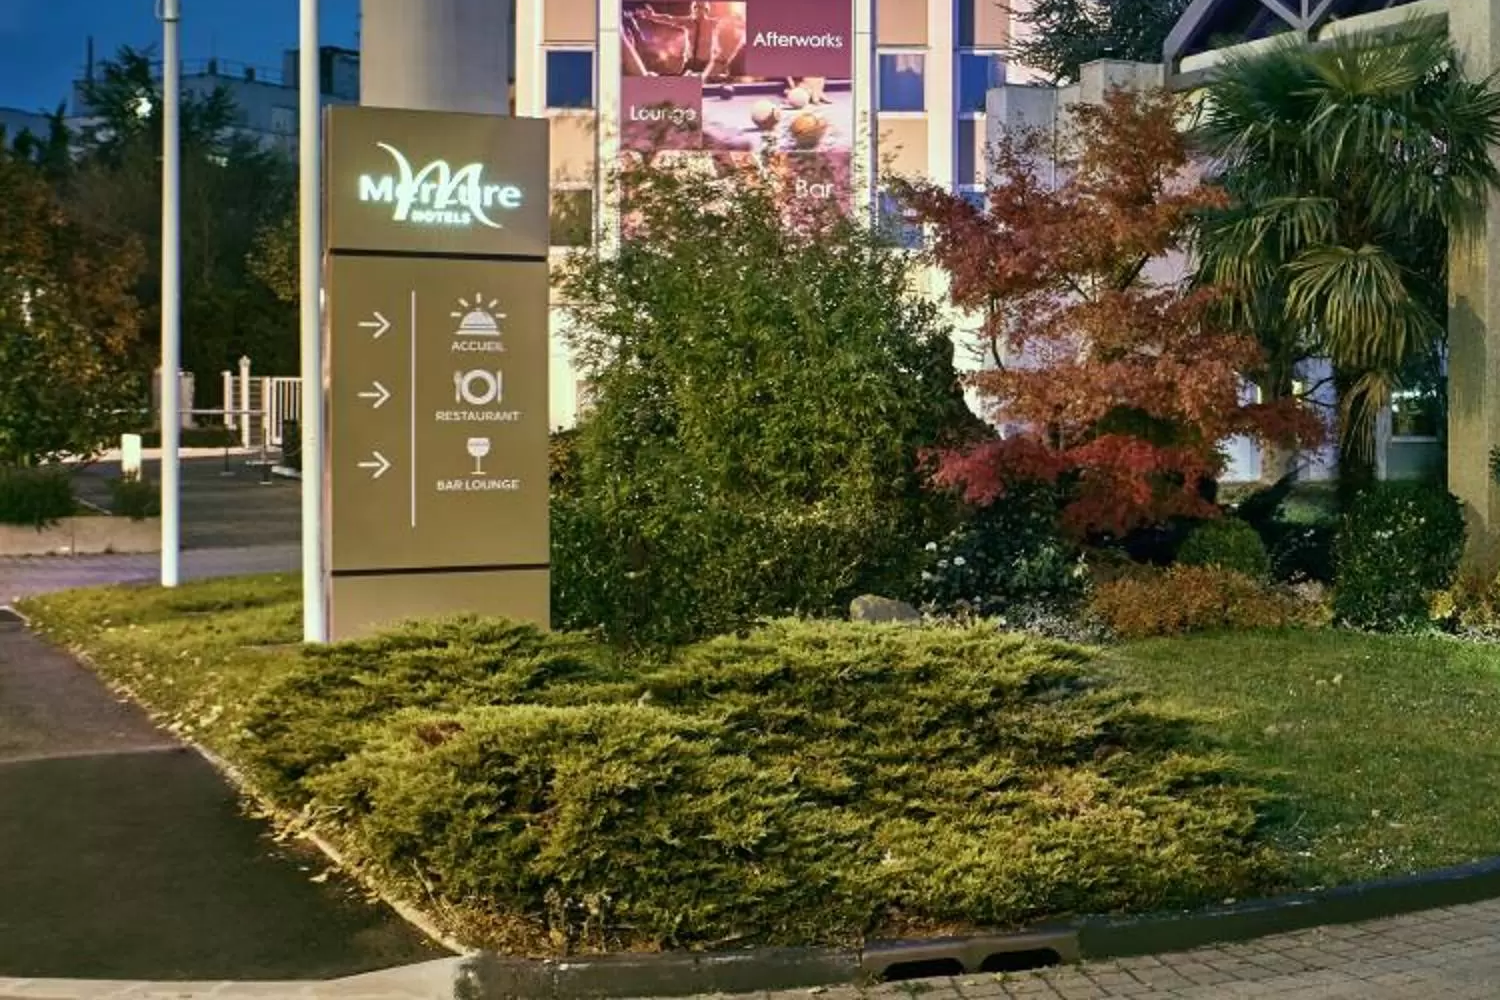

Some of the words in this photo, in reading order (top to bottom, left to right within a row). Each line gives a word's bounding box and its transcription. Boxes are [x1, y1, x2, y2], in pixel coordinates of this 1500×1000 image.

[753, 32, 844, 49] Afterworks
[359, 173, 522, 208] Mrure
[795, 178, 834, 200] Bar
[411, 210, 471, 225] HOTELS
[451, 341, 506, 352] ACCUEIL
[435, 410, 521, 422] RESTAURANT
[436, 480, 463, 491] BAR
[465, 479, 520, 491] LOUNGE
